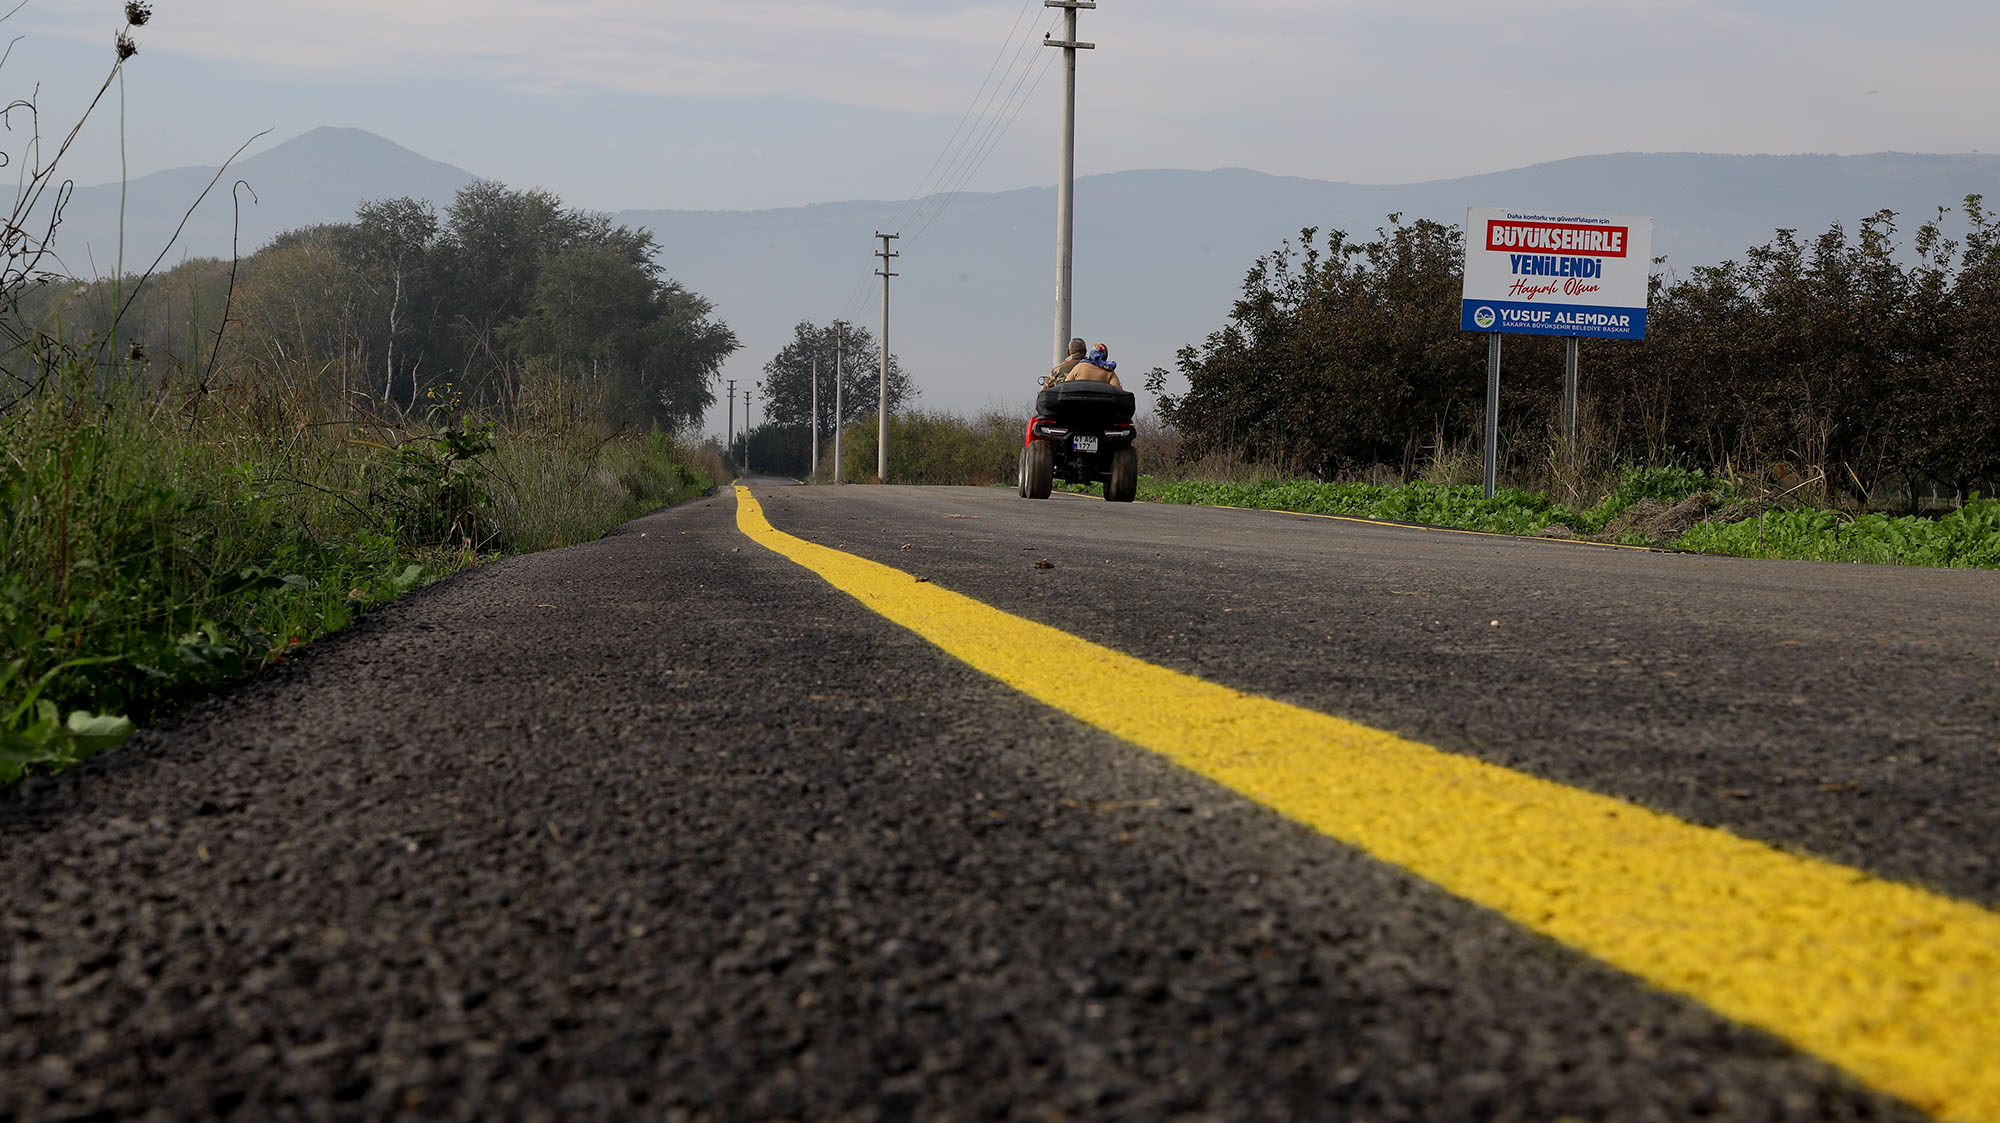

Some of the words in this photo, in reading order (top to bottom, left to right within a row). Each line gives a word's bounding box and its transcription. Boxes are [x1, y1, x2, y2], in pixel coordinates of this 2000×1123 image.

[1508, 278, 1558, 300] Hayırlı
[1563, 277, 1600, 296] Olsun
[1500, 309, 1551, 322] YUSUF
[1554, 312, 1630, 327] ALEMDAR
